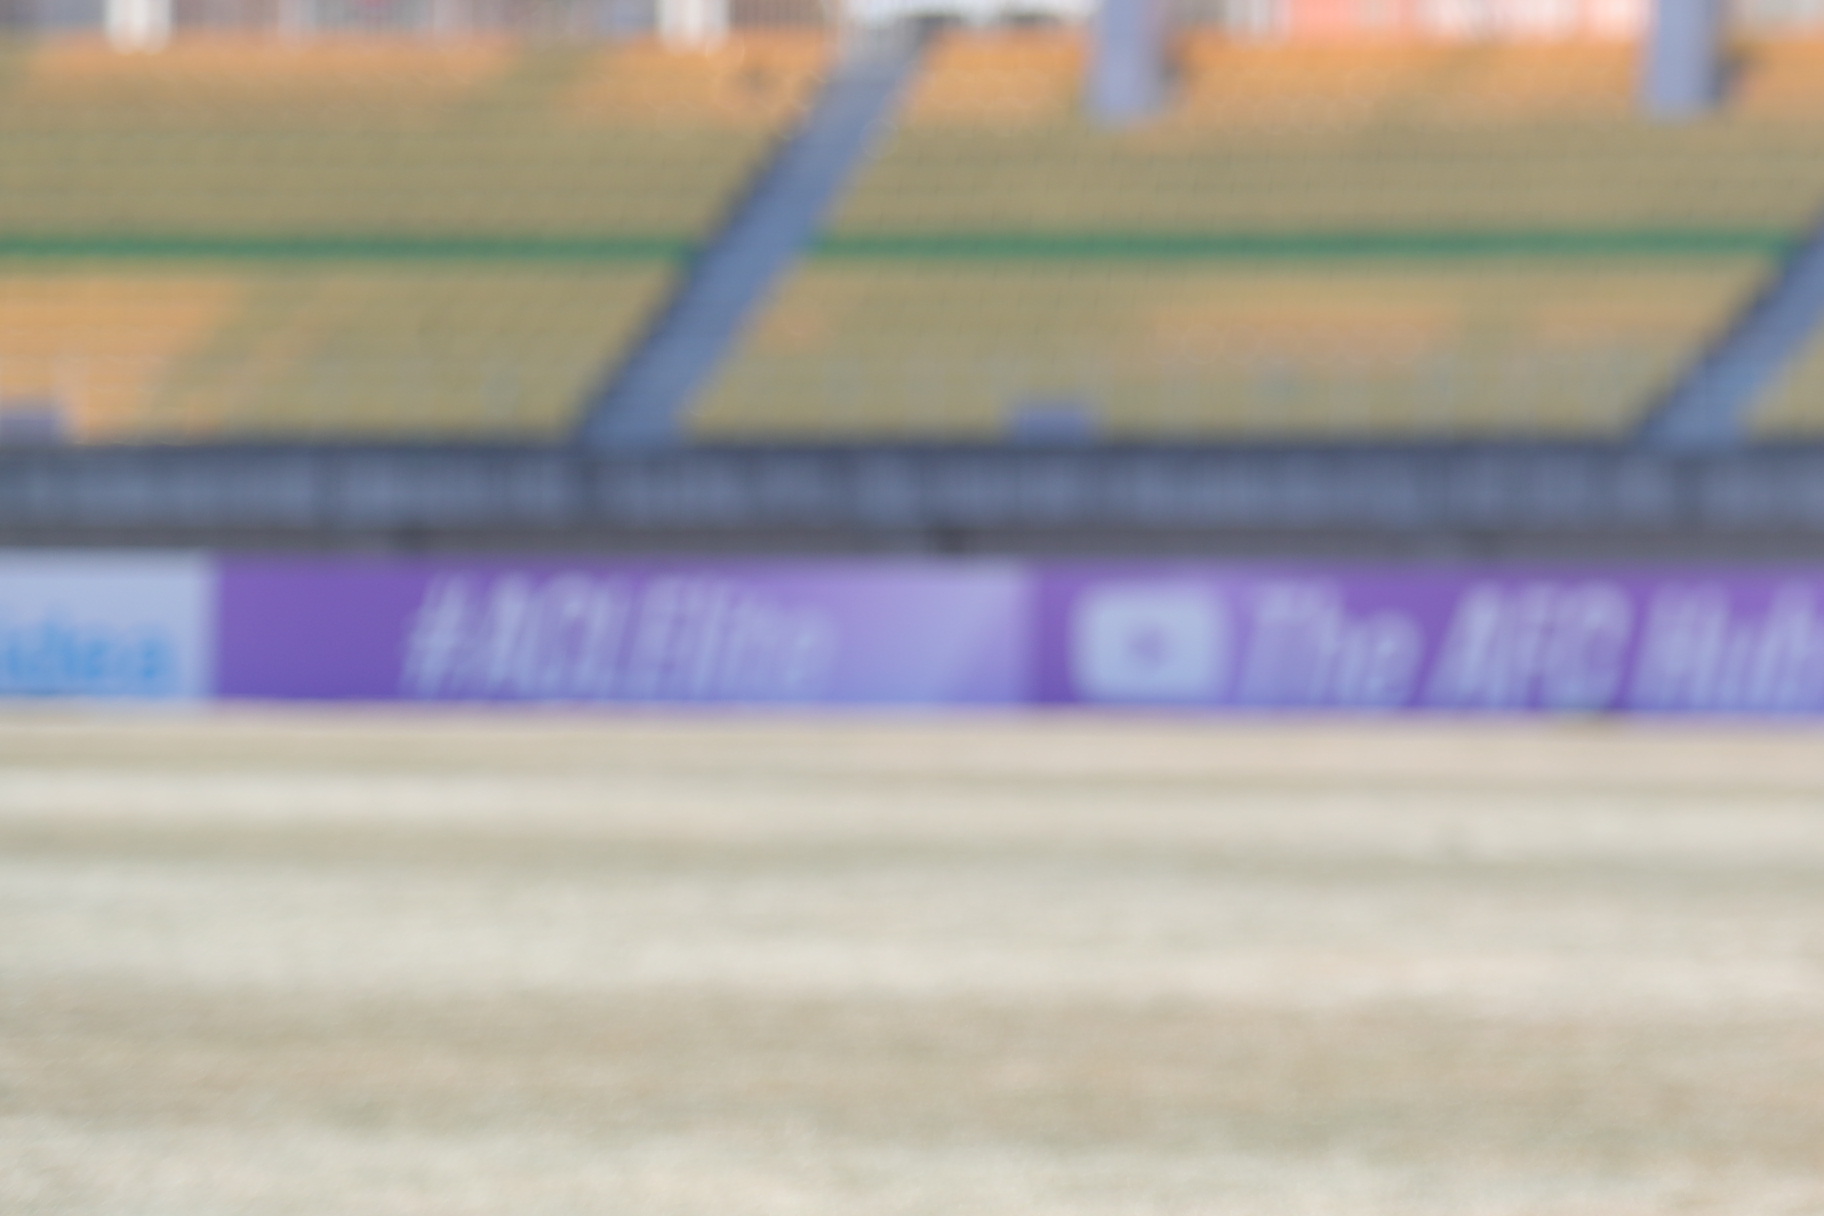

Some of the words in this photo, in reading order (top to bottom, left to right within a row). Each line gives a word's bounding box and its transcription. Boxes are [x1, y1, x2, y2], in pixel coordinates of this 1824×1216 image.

[405, 577, 834, 701] #ACLElite
[1243, 584, 1418, 704] The
[1428, 582, 1634, 706] AFC
